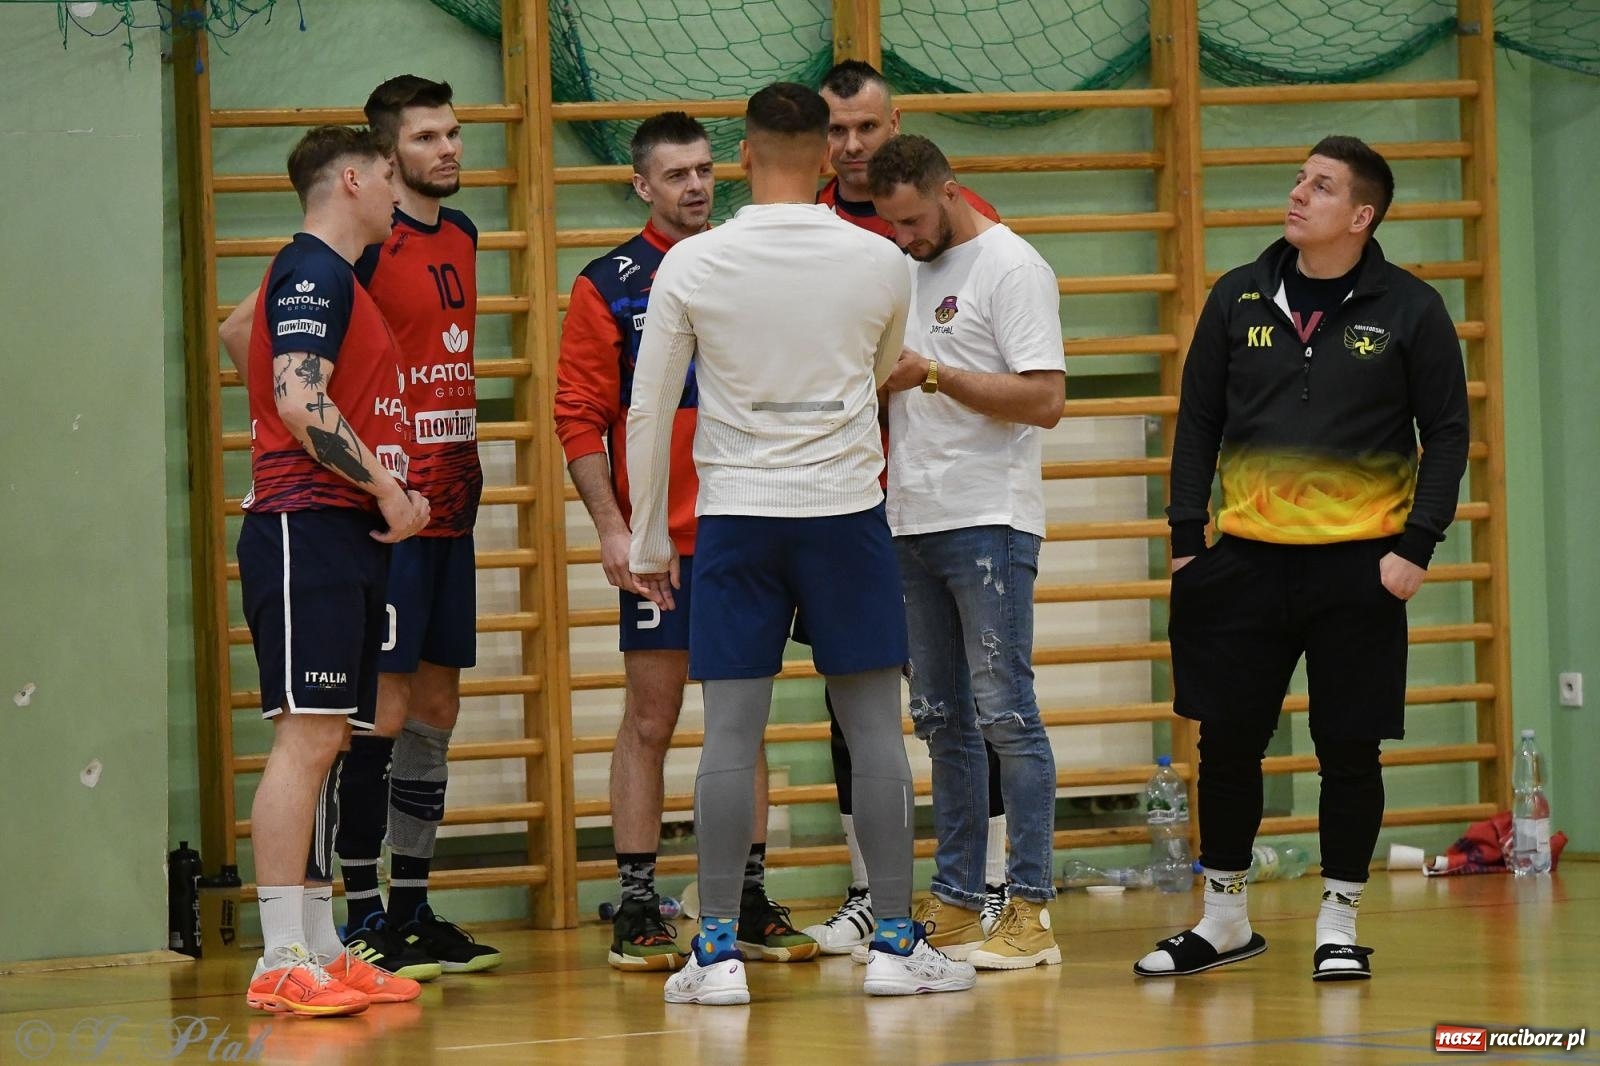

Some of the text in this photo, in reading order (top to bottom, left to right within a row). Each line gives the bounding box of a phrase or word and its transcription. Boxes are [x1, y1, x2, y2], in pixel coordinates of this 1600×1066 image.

[427, 263, 465, 310] 10
[278, 295, 330, 308] KATOLIK
[279, 320, 324, 334] nowiny.pl
[1247, 326, 1275, 347] KK
[410, 362, 475, 385] KATOL
[305, 671, 347, 683] ITALIA
